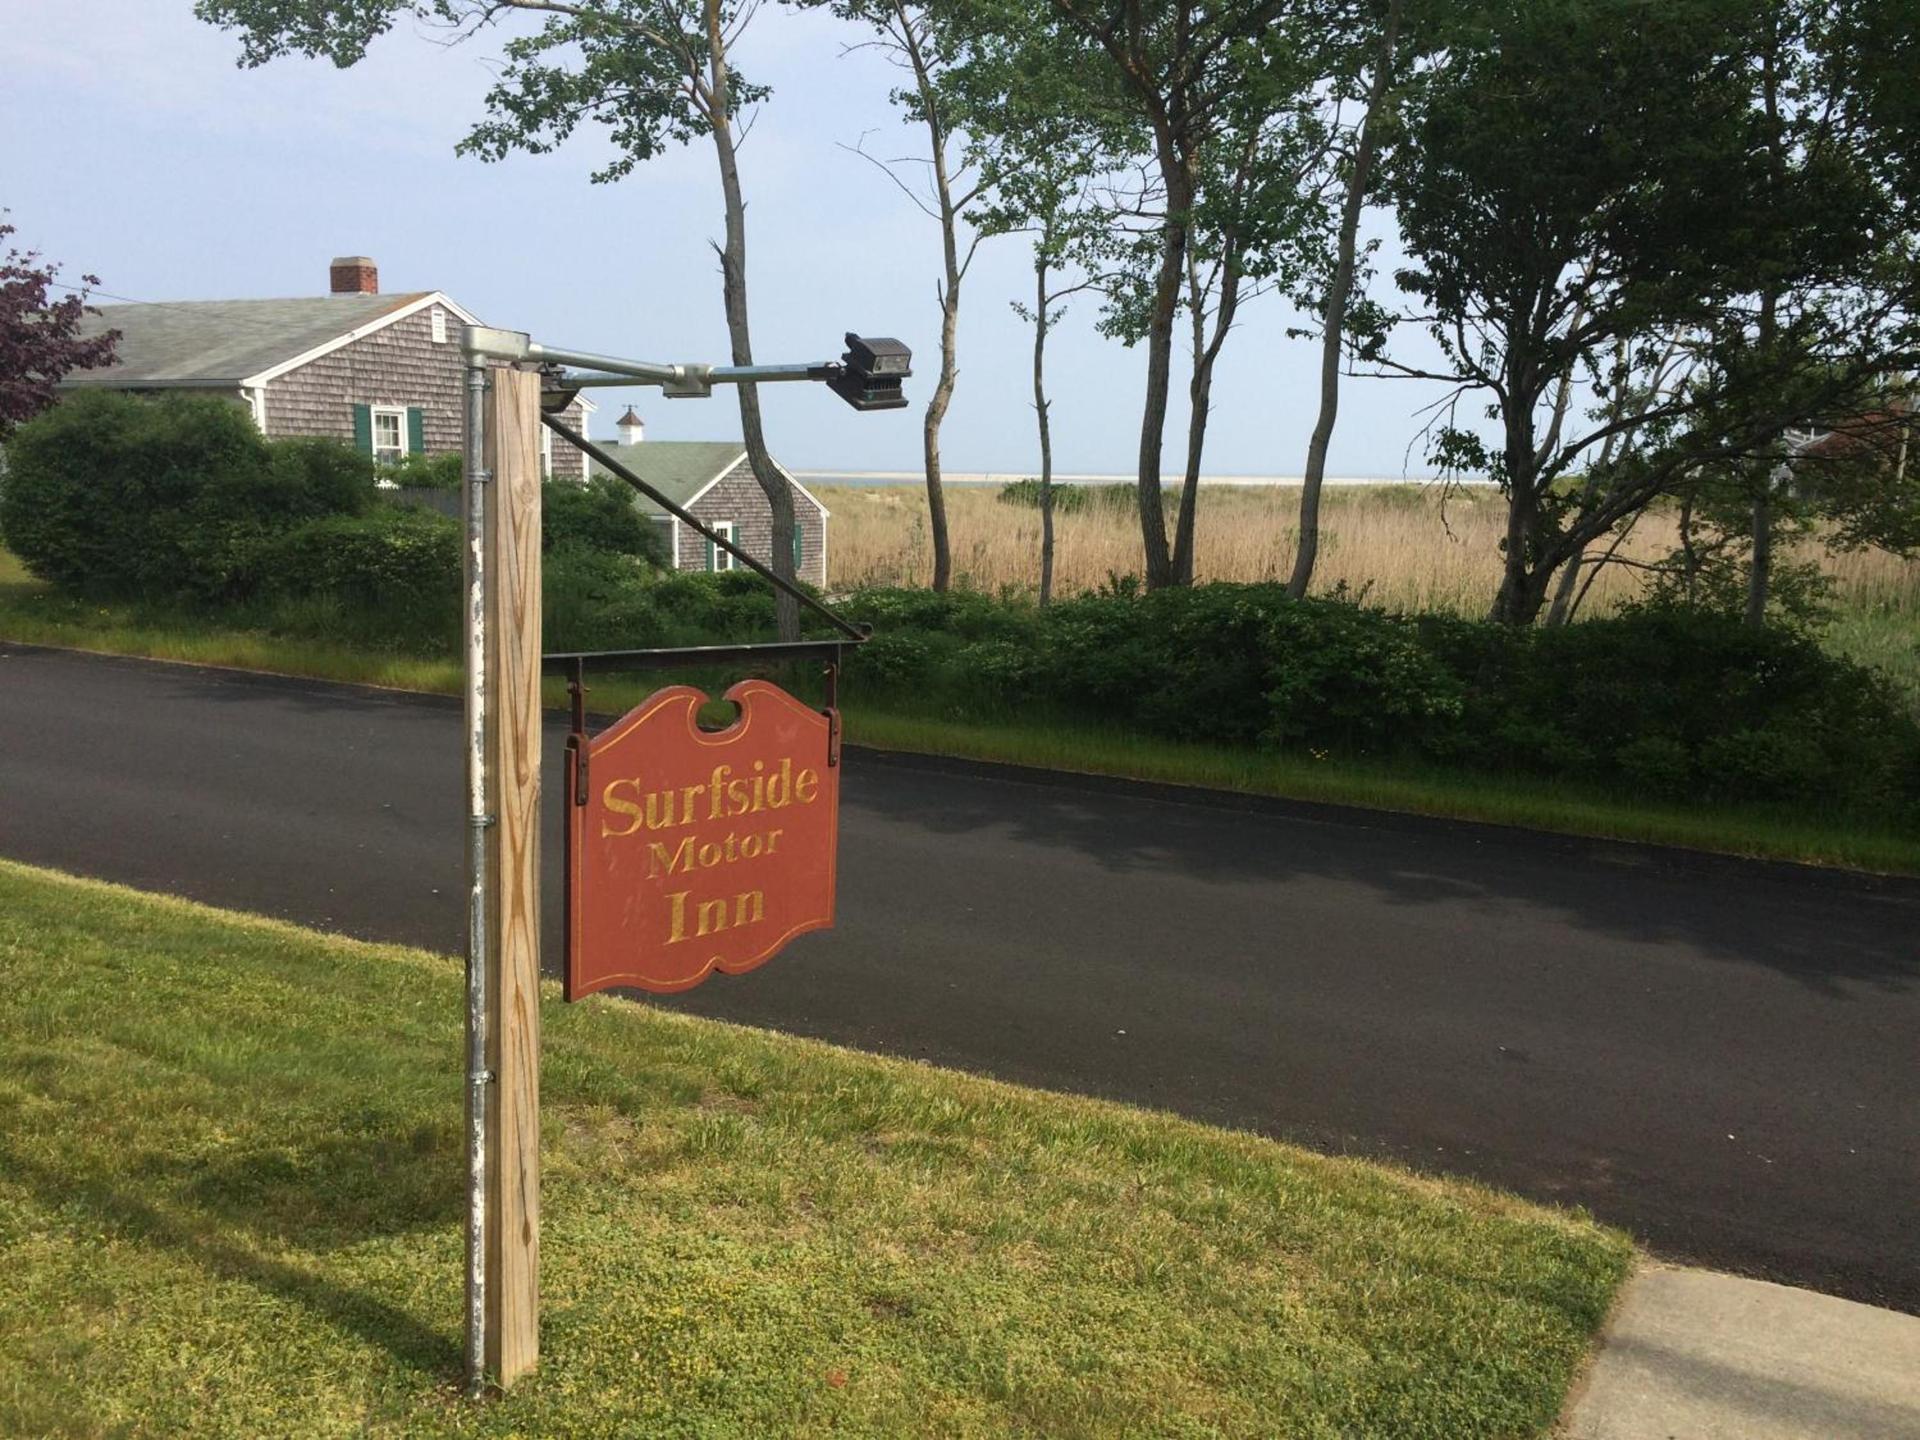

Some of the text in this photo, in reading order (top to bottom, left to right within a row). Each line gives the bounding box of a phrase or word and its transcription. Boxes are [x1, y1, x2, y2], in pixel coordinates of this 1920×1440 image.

[602, 757, 819, 839] Surfside
[646, 829, 783, 880] Motor
[663, 890, 766, 945] Inn
